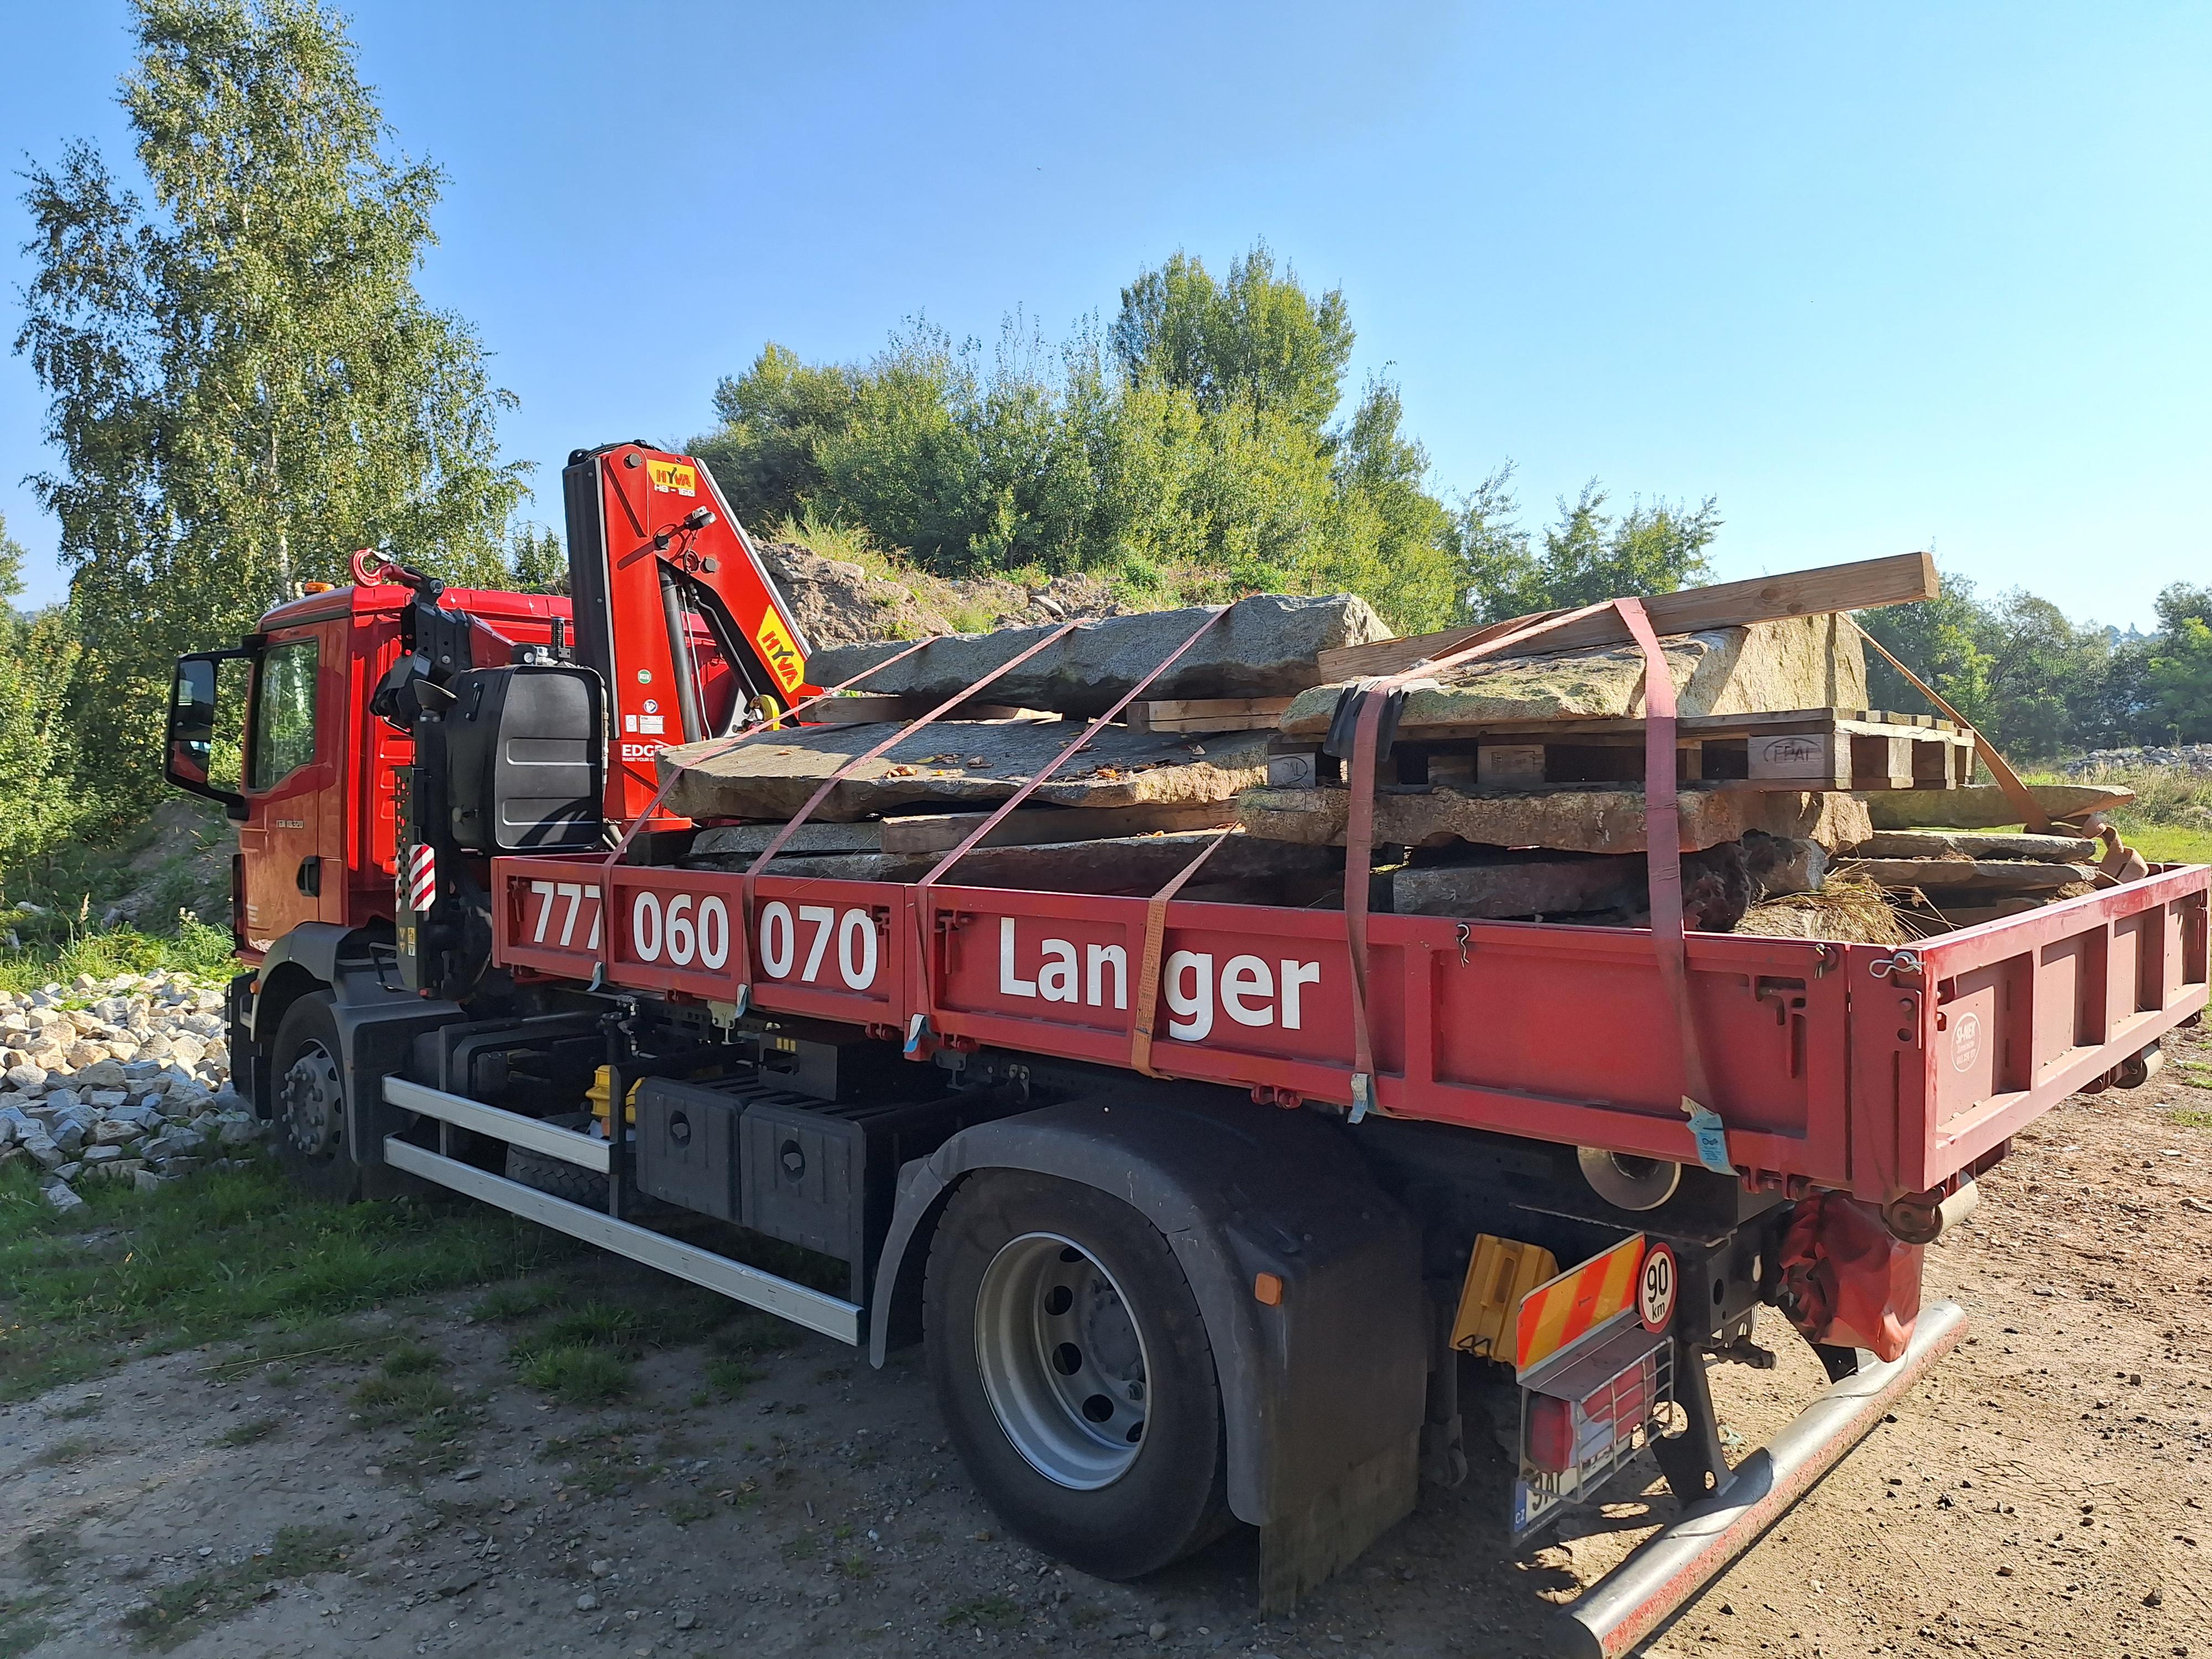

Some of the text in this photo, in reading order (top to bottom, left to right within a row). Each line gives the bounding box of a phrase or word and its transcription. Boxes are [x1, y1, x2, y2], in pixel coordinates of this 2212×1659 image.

[656, 467, 691, 487] HYVA
[761, 630, 799, 687] HYVA
[531, 880, 878, 990] 777 060 070
[1647, 1258, 1668, 1303] 90
[1652, 1302, 1665, 1321] km
[1515, 1508, 1526, 1525] CZ
